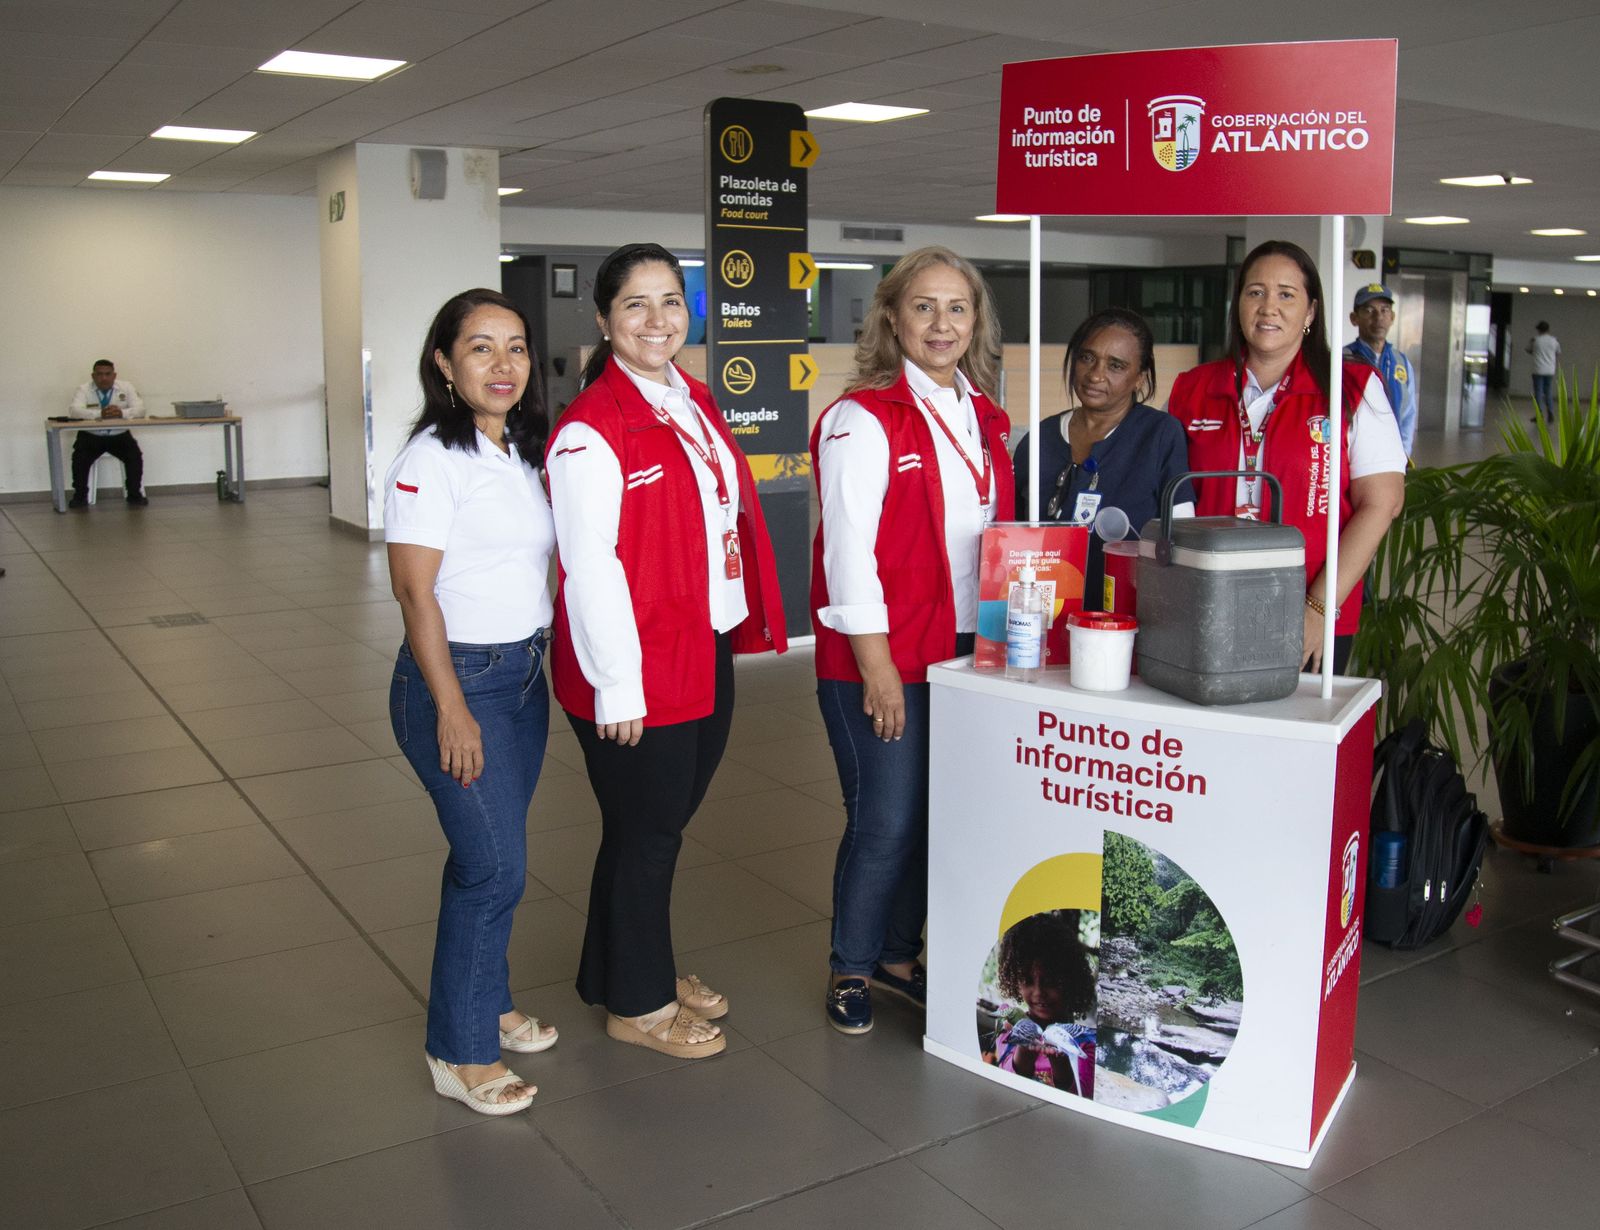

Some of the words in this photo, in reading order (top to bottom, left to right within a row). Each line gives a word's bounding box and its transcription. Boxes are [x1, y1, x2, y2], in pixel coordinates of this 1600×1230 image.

[1023, 106, 1072, 126] Punto
[1077, 104, 1101, 124] de
[1211, 109, 1331, 128] GOBERNACIÓN
[1335, 111, 1367, 124] DEL
[1011, 124, 1115, 147] información
[1211, 125, 1369, 153] ATLÁNTICO
[1024, 148, 1098, 167] turística
[720, 175, 779, 192] Plazoleta
[781, 178, 797, 193] de
[720, 192, 773, 206] comidas
[721, 208, 743, 219] Food
[745, 210, 768, 220] court
[721, 302, 761, 316] Baños
[722, 318, 752, 328] Toilets
[723, 408, 779, 425] Llegadas
[730, 424, 760, 434] rrivals
[1310, 444, 1320, 459] DEL
[1045, 549, 1061, 559] aquí
[1038, 710, 1130, 750] Punto
[1141, 729, 1183, 759] de
[1016, 737, 1207, 795] información
[1041, 777, 1173, 823] turística
